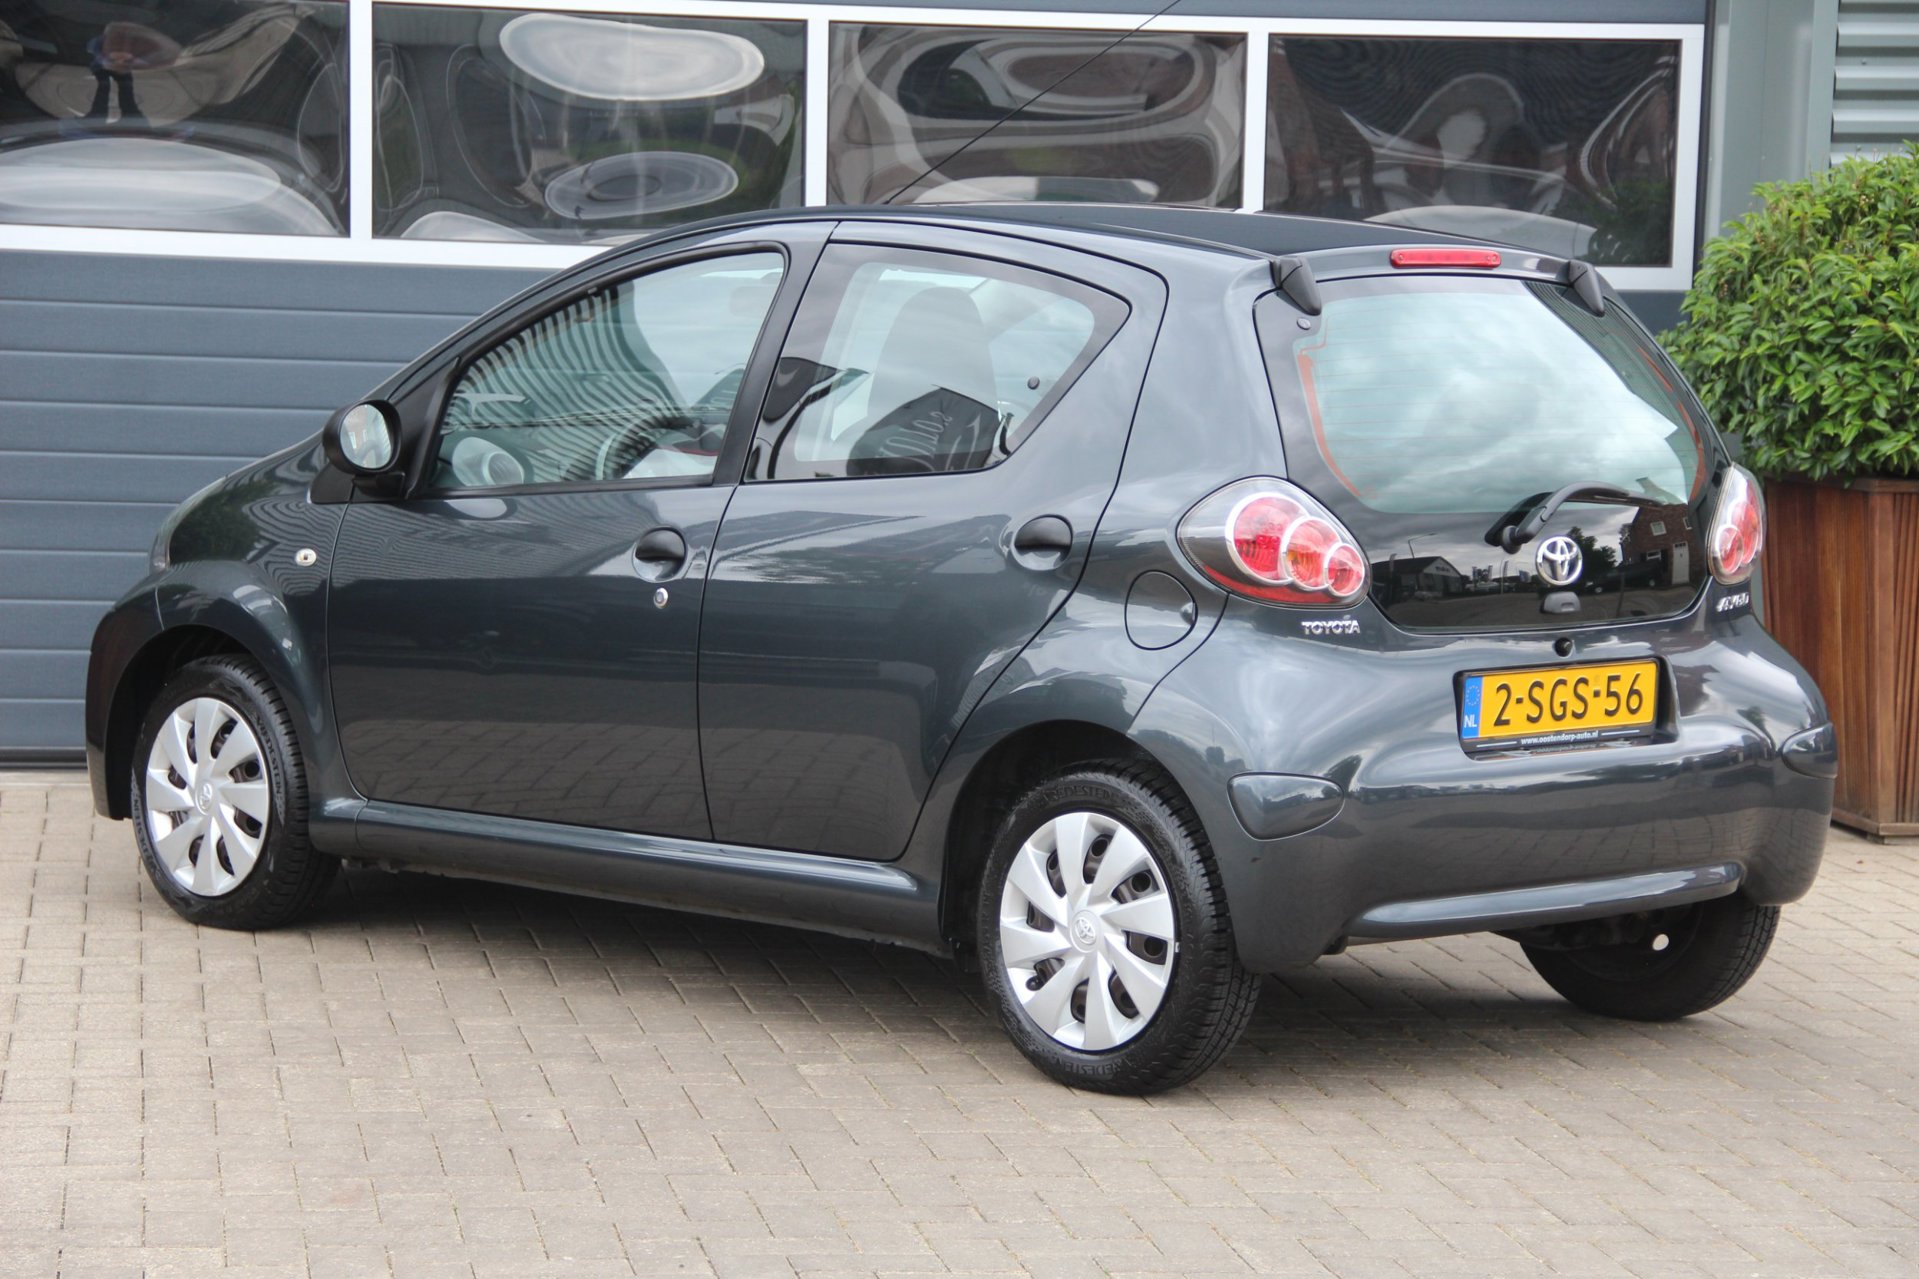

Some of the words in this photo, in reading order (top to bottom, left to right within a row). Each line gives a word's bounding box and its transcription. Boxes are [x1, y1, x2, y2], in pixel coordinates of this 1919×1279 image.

[1301, 620, 1360, 635] TOYOTA
[1493, 673, 1644, 727] 2-SGS-56
[1464, 714, 1477, 728] NL
[1520, 730, 1599, 745] www.oostendorp-auto.nl
